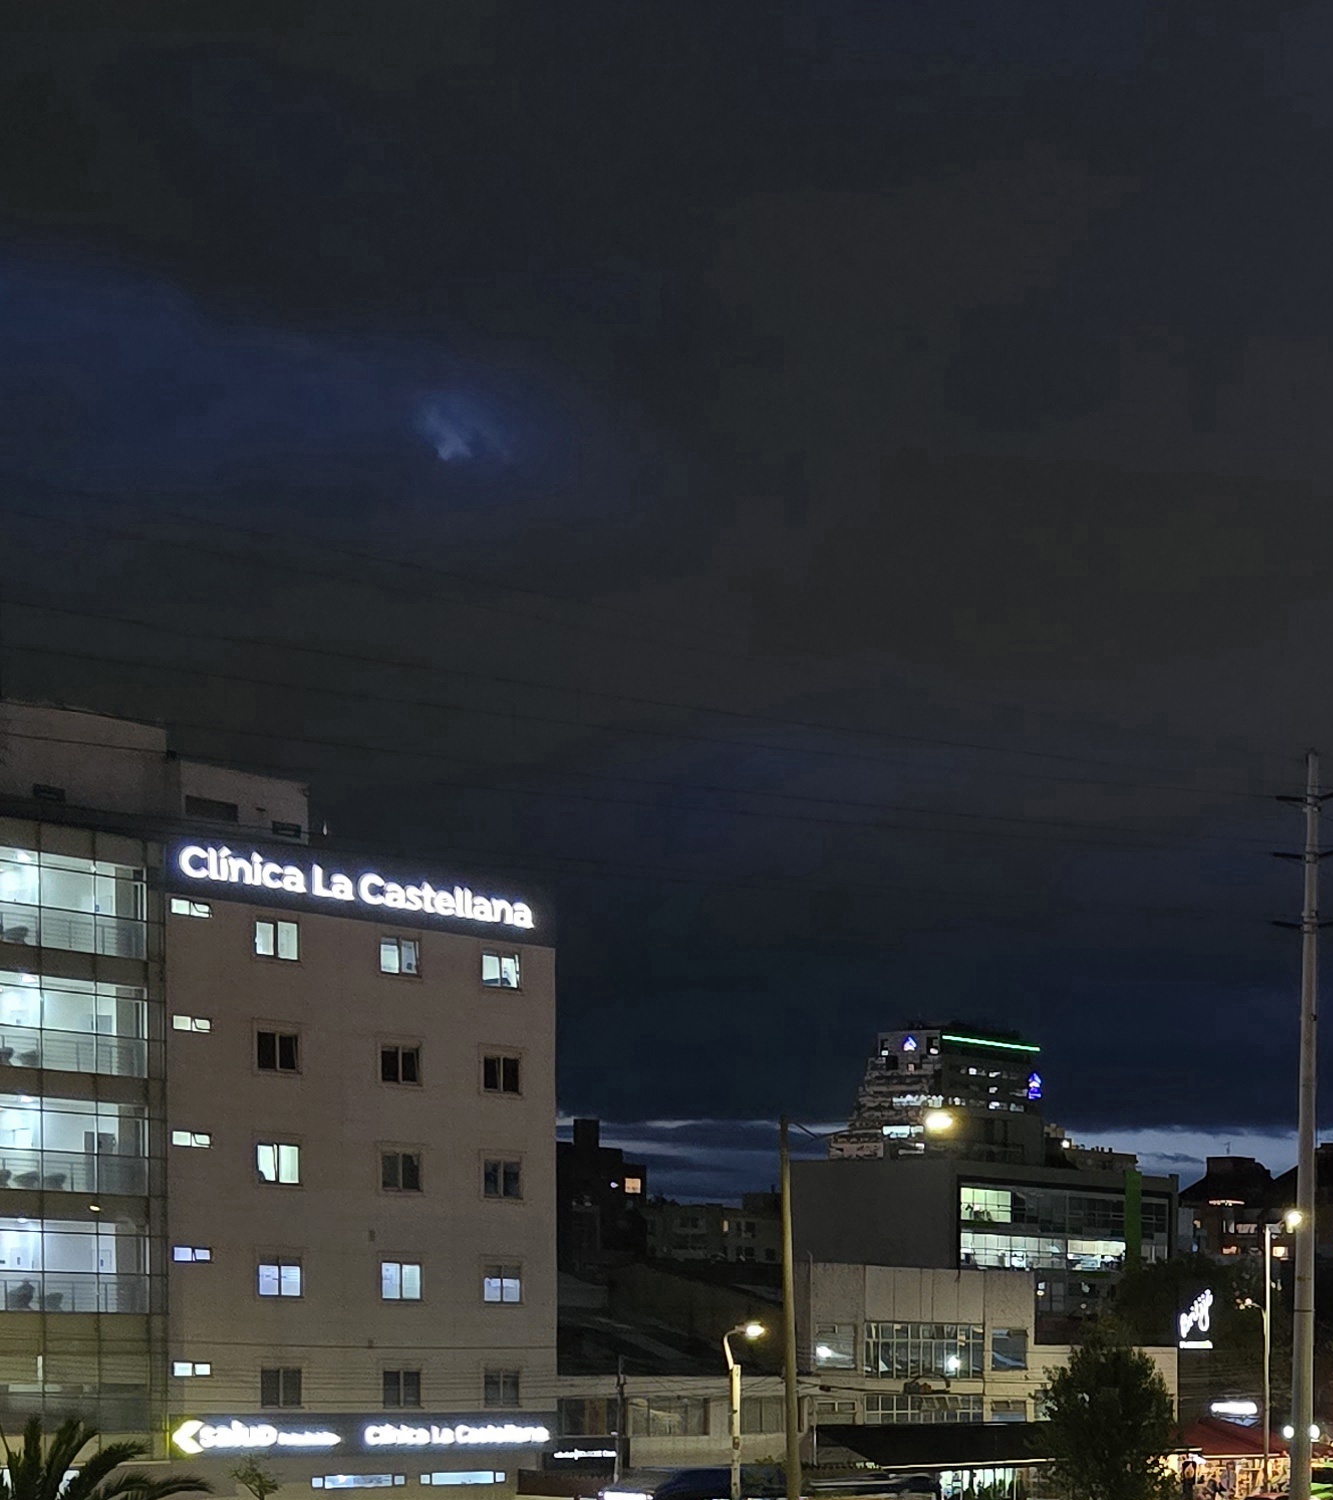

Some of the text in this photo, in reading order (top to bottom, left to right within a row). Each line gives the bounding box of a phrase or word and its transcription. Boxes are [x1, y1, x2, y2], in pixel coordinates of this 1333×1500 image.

[179, 845, 534, 929] Clínica La Castellana
